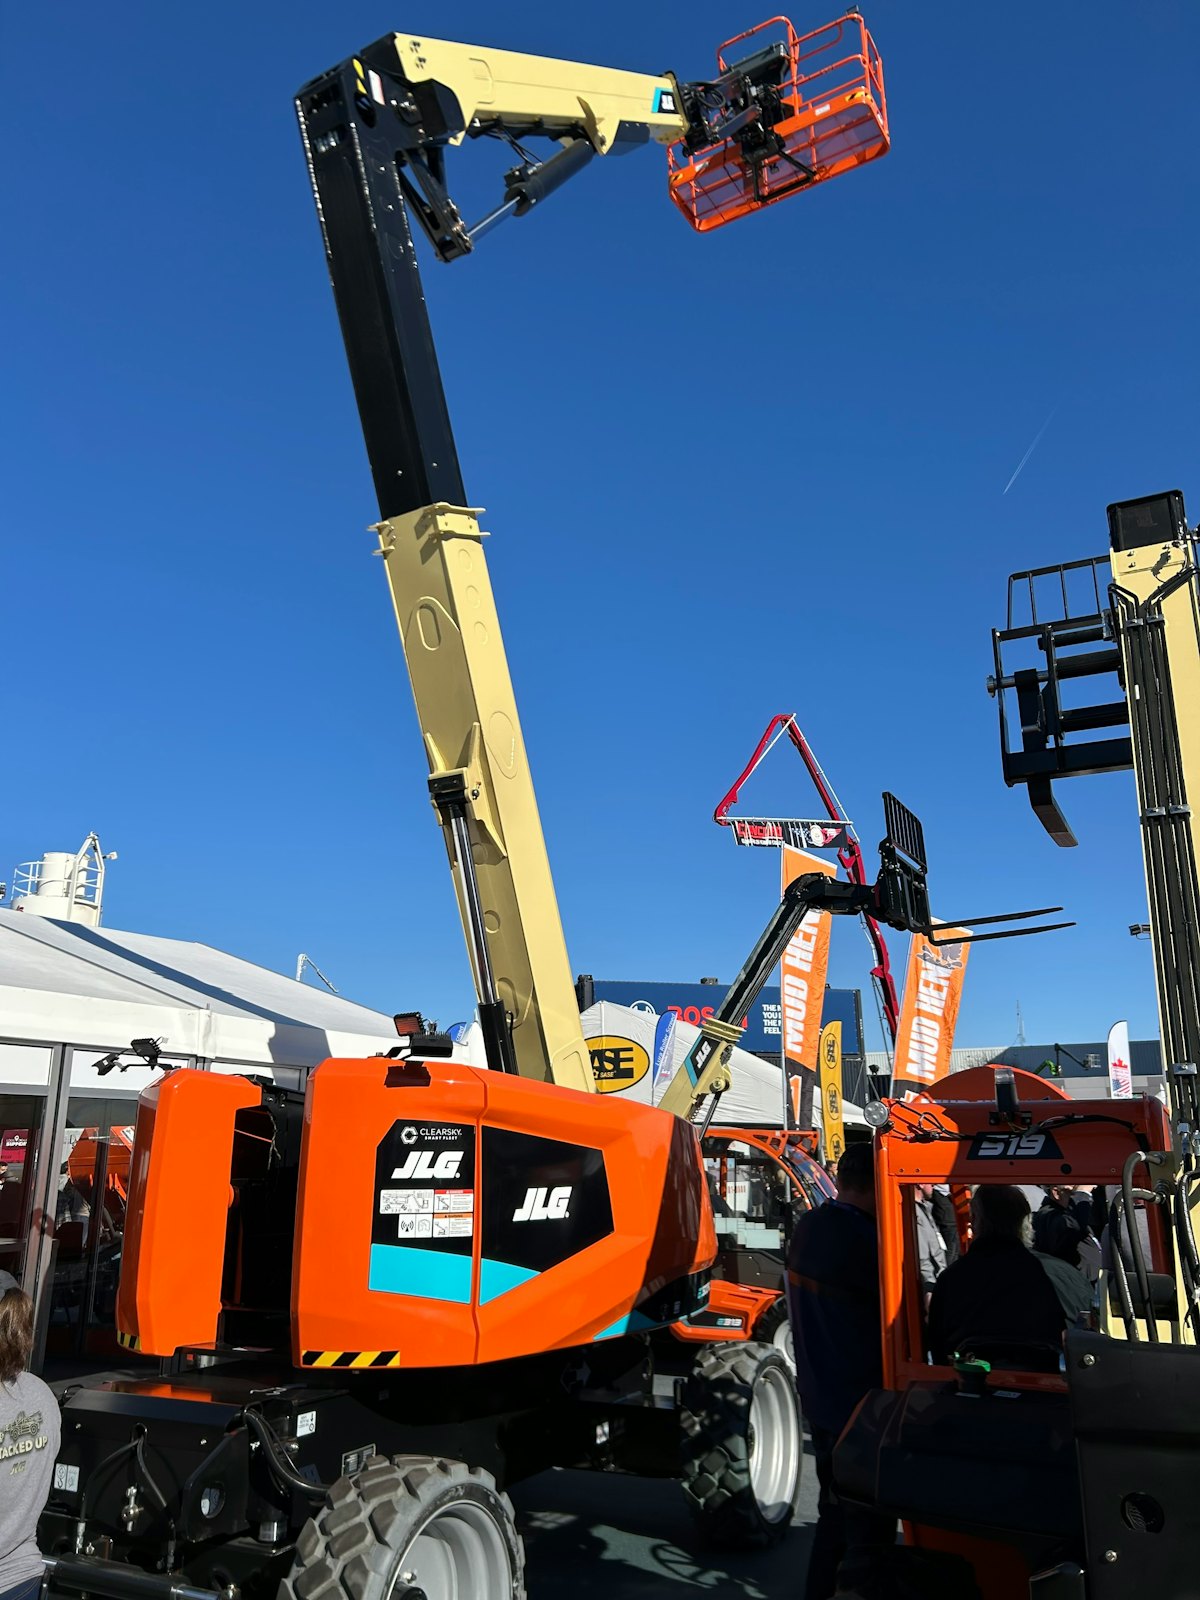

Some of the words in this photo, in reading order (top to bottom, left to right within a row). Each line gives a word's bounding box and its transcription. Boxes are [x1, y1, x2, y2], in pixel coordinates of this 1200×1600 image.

[914, 960, 952, 1016] HEN
[763, 1019, 777, 1027] THE
[784, 974, 808, 1053] MUD
[695, 1040, 712, 1068] JLG
[906, 1016, 940, 1080] MUD
[589, 1047, 634, 1080] ASE
[420, 1128, 462, 1136] CLEARSKY
[391, 1151, 465, 1179] JLG
[512, 1186, 573, 1222] JLG
[35, 1436, 49, 1449] UP
